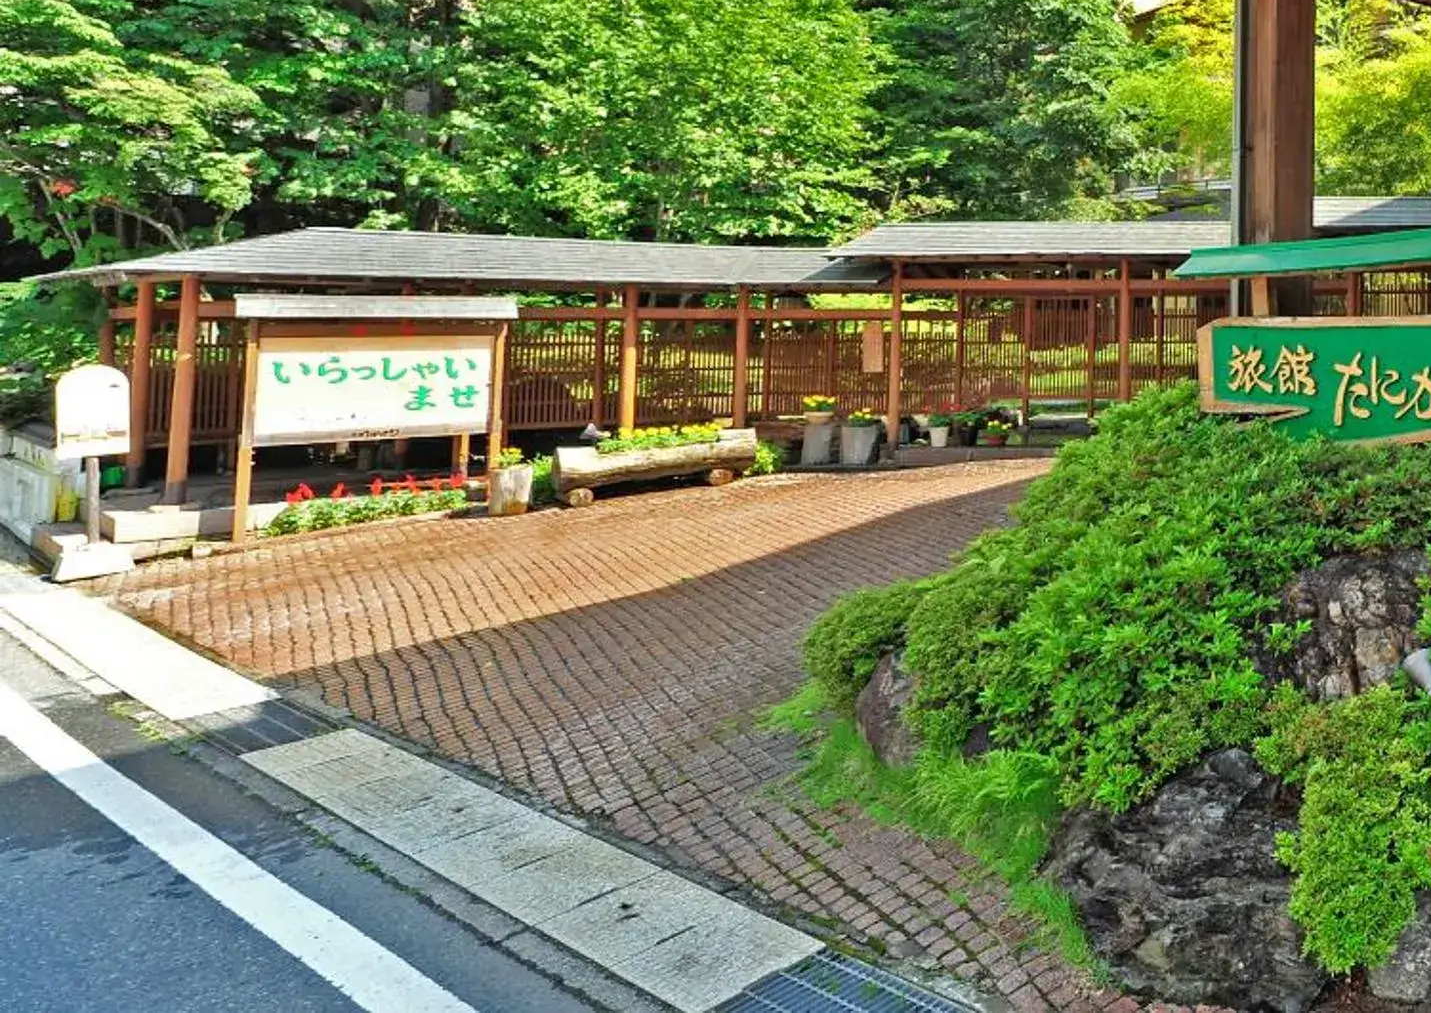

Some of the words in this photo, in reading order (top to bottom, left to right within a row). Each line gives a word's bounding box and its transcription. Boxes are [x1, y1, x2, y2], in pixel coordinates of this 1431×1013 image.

[271, 356, 477, 384] いらっしゃい
[1227, 344, 1317, 396] 旅館
[404, 385, 479, 411] ませ
